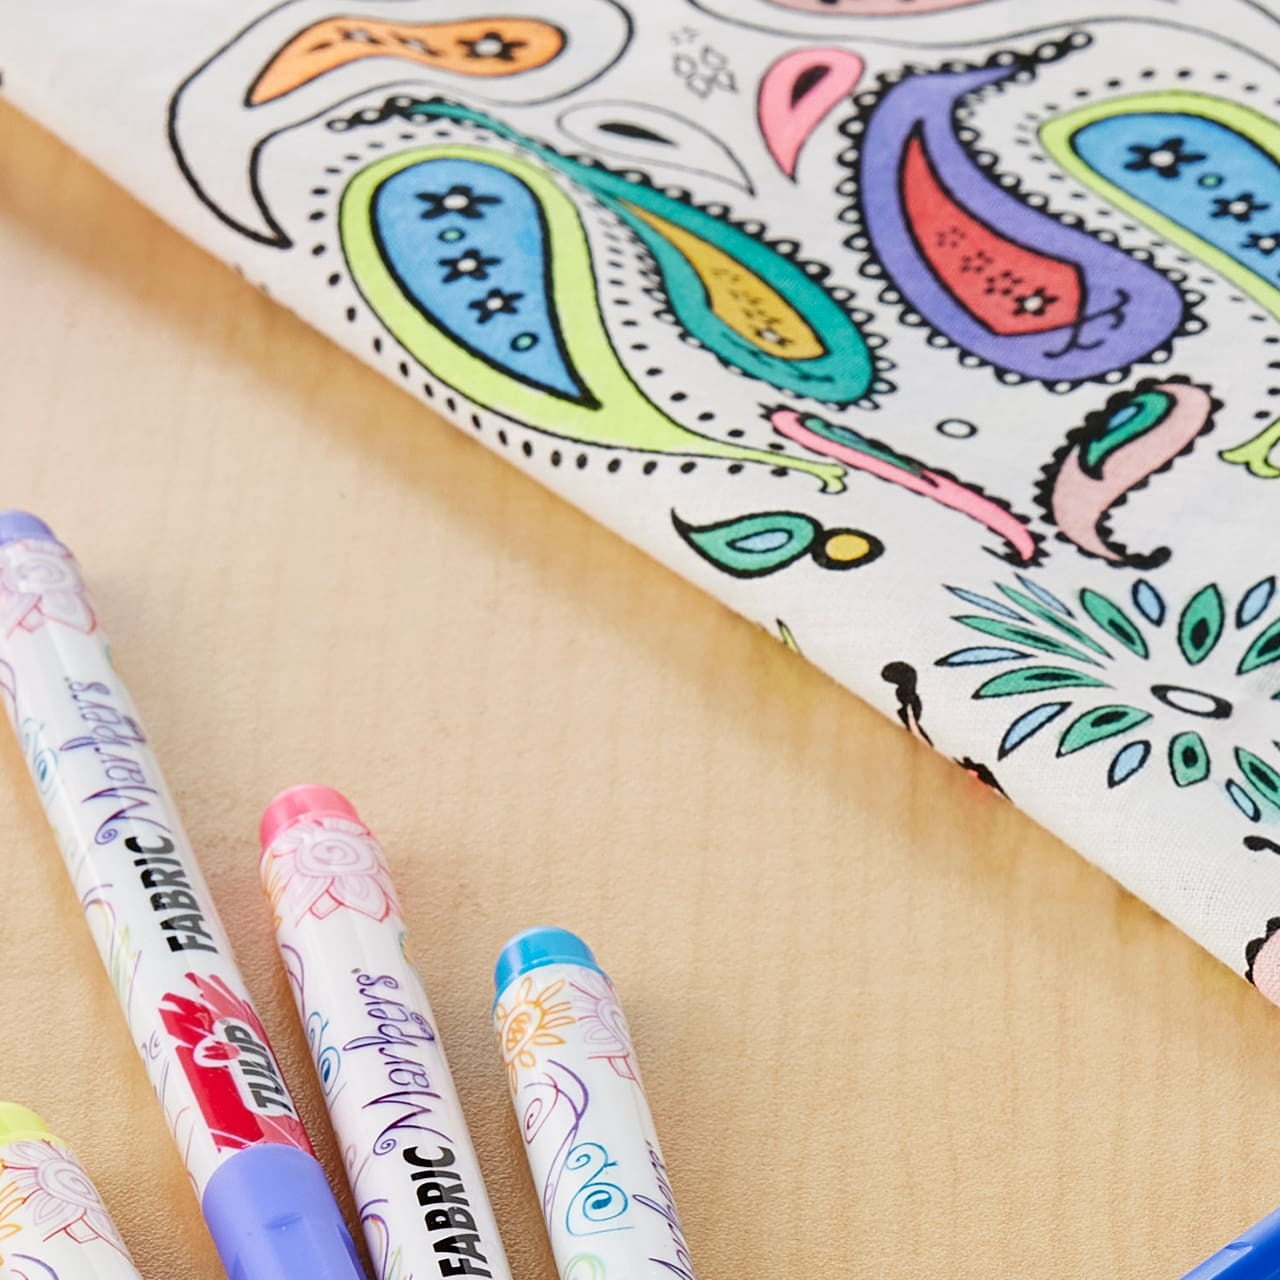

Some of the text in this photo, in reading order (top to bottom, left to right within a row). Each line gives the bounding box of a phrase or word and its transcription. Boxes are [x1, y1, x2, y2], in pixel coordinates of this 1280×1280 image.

[59, 680, 292, 1114] TULIP FABRIC Markers
[342, 973, 454, 1156] Markers
[403, 1145, 493, 1280] FABRIC
